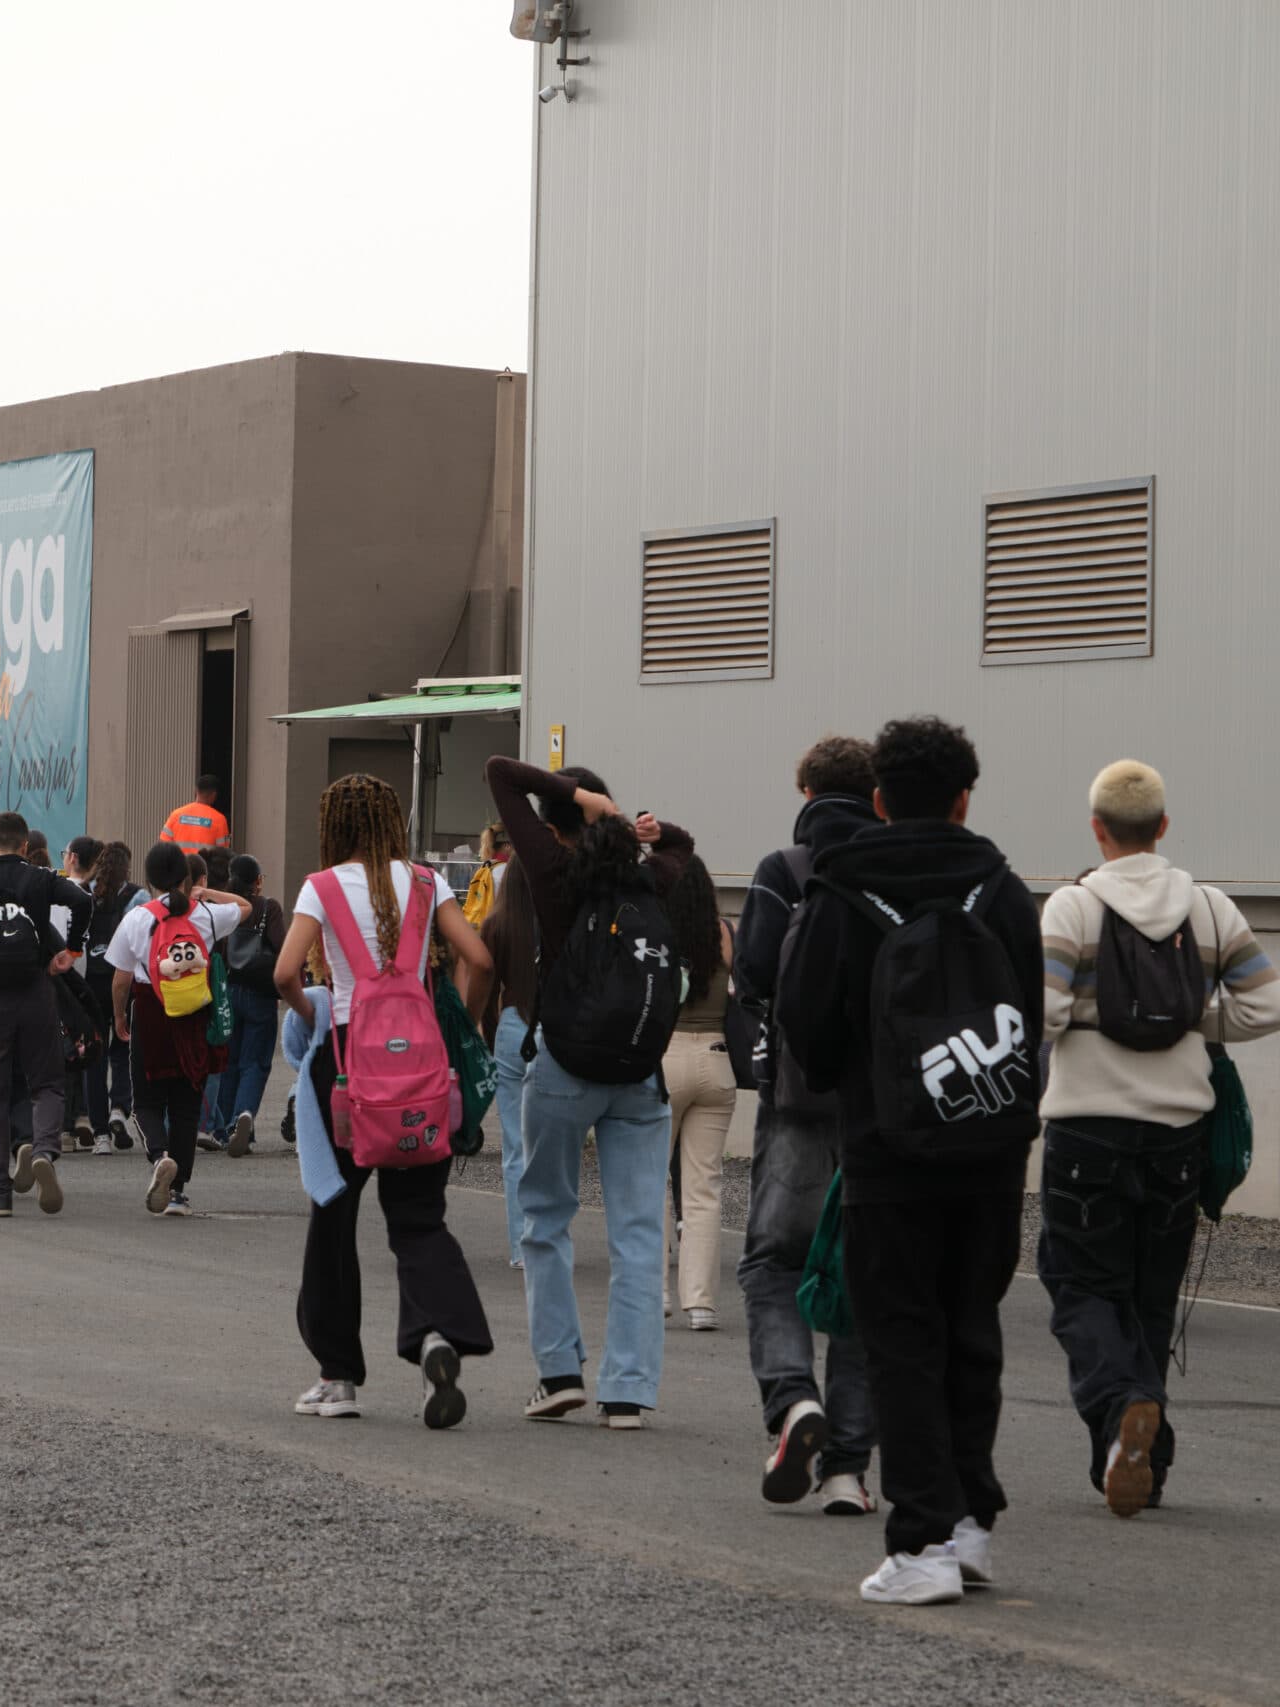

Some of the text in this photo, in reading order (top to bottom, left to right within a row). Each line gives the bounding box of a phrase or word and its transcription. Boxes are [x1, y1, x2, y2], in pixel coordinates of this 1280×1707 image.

[7, 691, 78, 812] Canarias
[646, 973, 654, 1005] UNDER
[920, 1003, 1025, 1099] FILA
